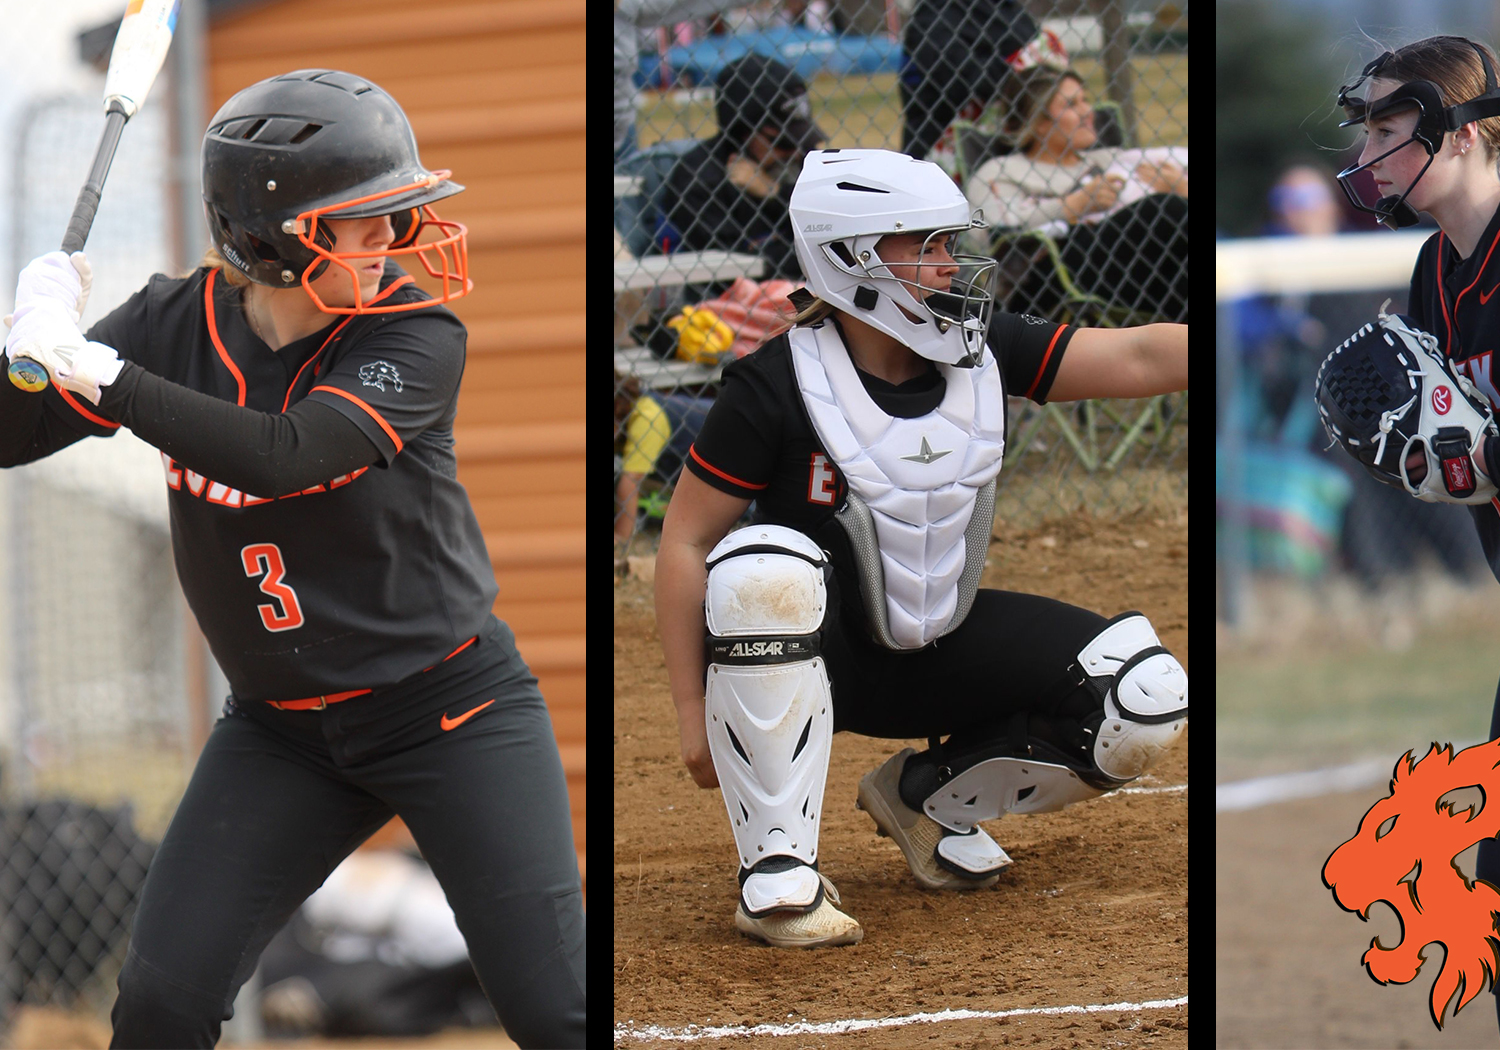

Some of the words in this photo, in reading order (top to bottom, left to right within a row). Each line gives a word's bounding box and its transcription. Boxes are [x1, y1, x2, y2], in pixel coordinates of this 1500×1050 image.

[222, 243, 250, 272] schutt
[241, 543, 305, 633] 3
[729, 641, 783, 657] ALL-STAR
